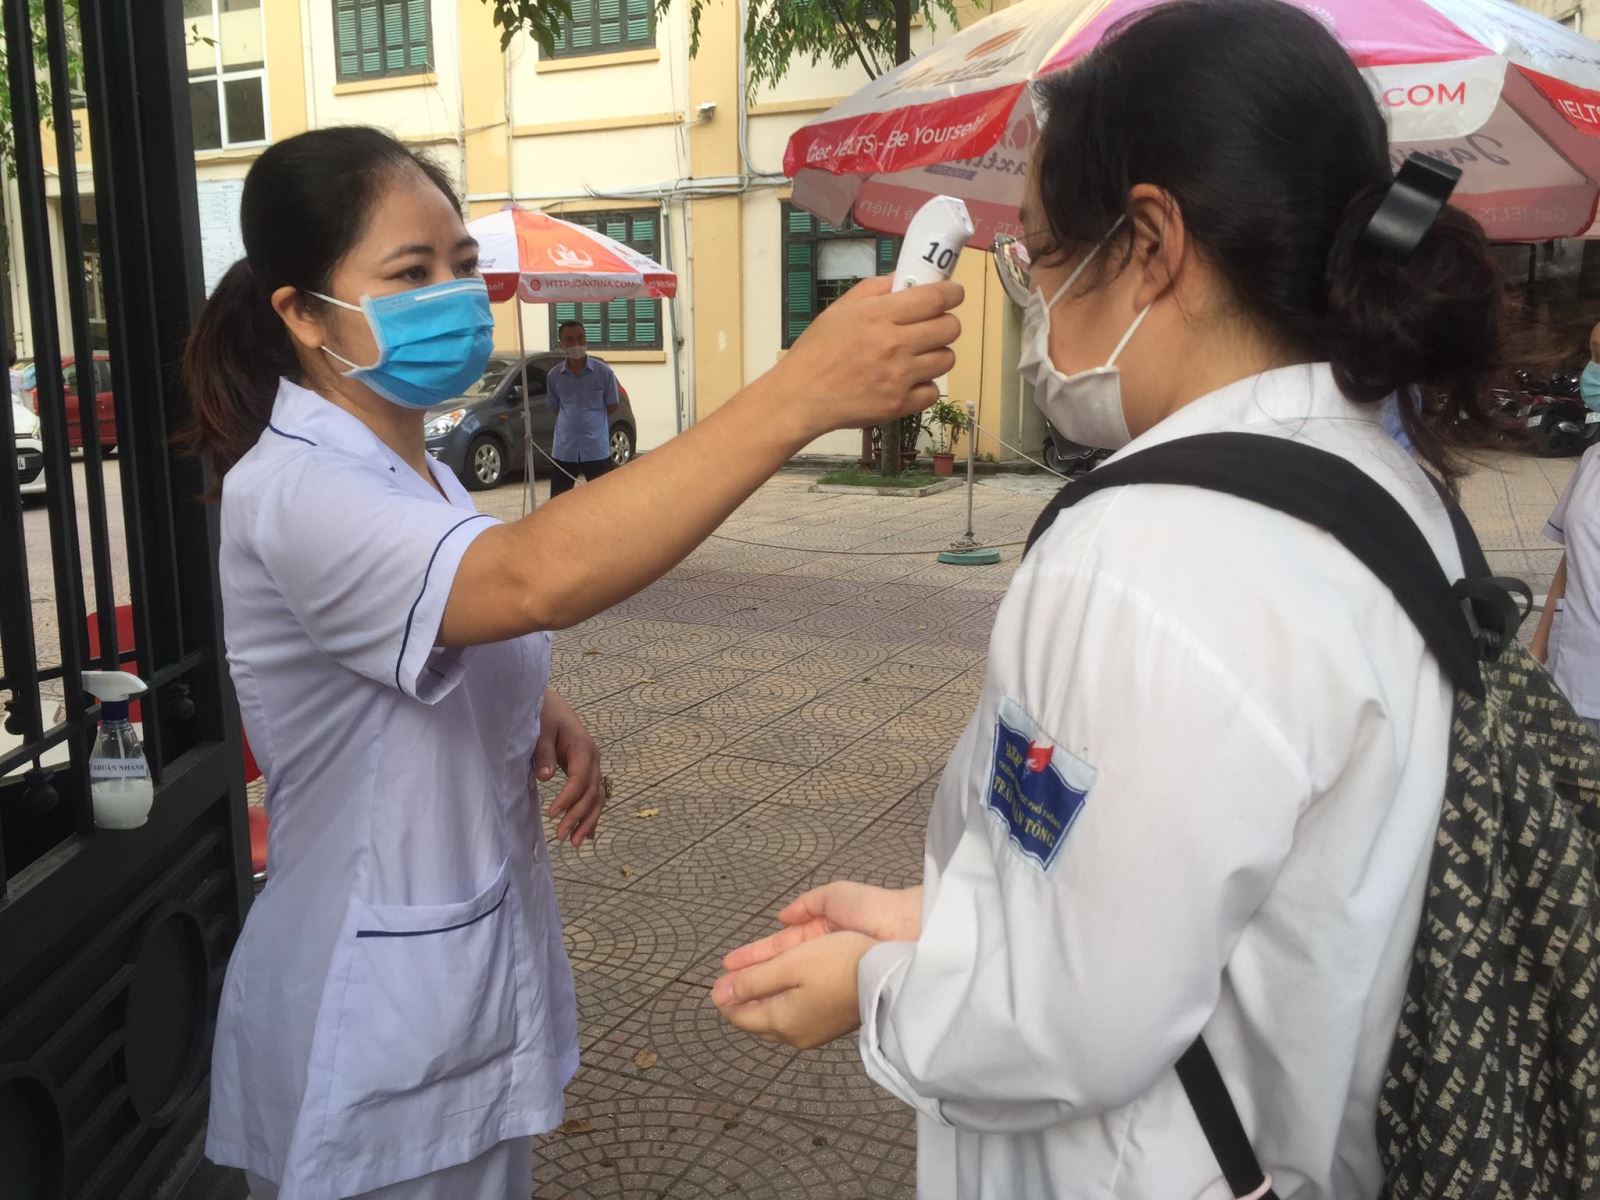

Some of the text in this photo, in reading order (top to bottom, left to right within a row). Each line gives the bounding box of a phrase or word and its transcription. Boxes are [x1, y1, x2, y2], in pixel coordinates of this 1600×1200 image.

[1380, 81, 1467, 108] COM
[806, 138, 832, 163] Get
[832, 134, 876, 157] IELTS
[887, 129, 909, 149] Be
[914, 112, 987, 145] Yourself
[1452, 752, 1488, 787] WTF
[1549, 753, 1590, 771] WTF
[1443, 868, 1482, 908] WTF
[1464, 960, 1496, 1004] WTF
[1432, 1018, 1462, 1064] WTF
[1436, 1066, 1467, 1111] WTF
[1439, 1112, 1468, 1157] WTF
